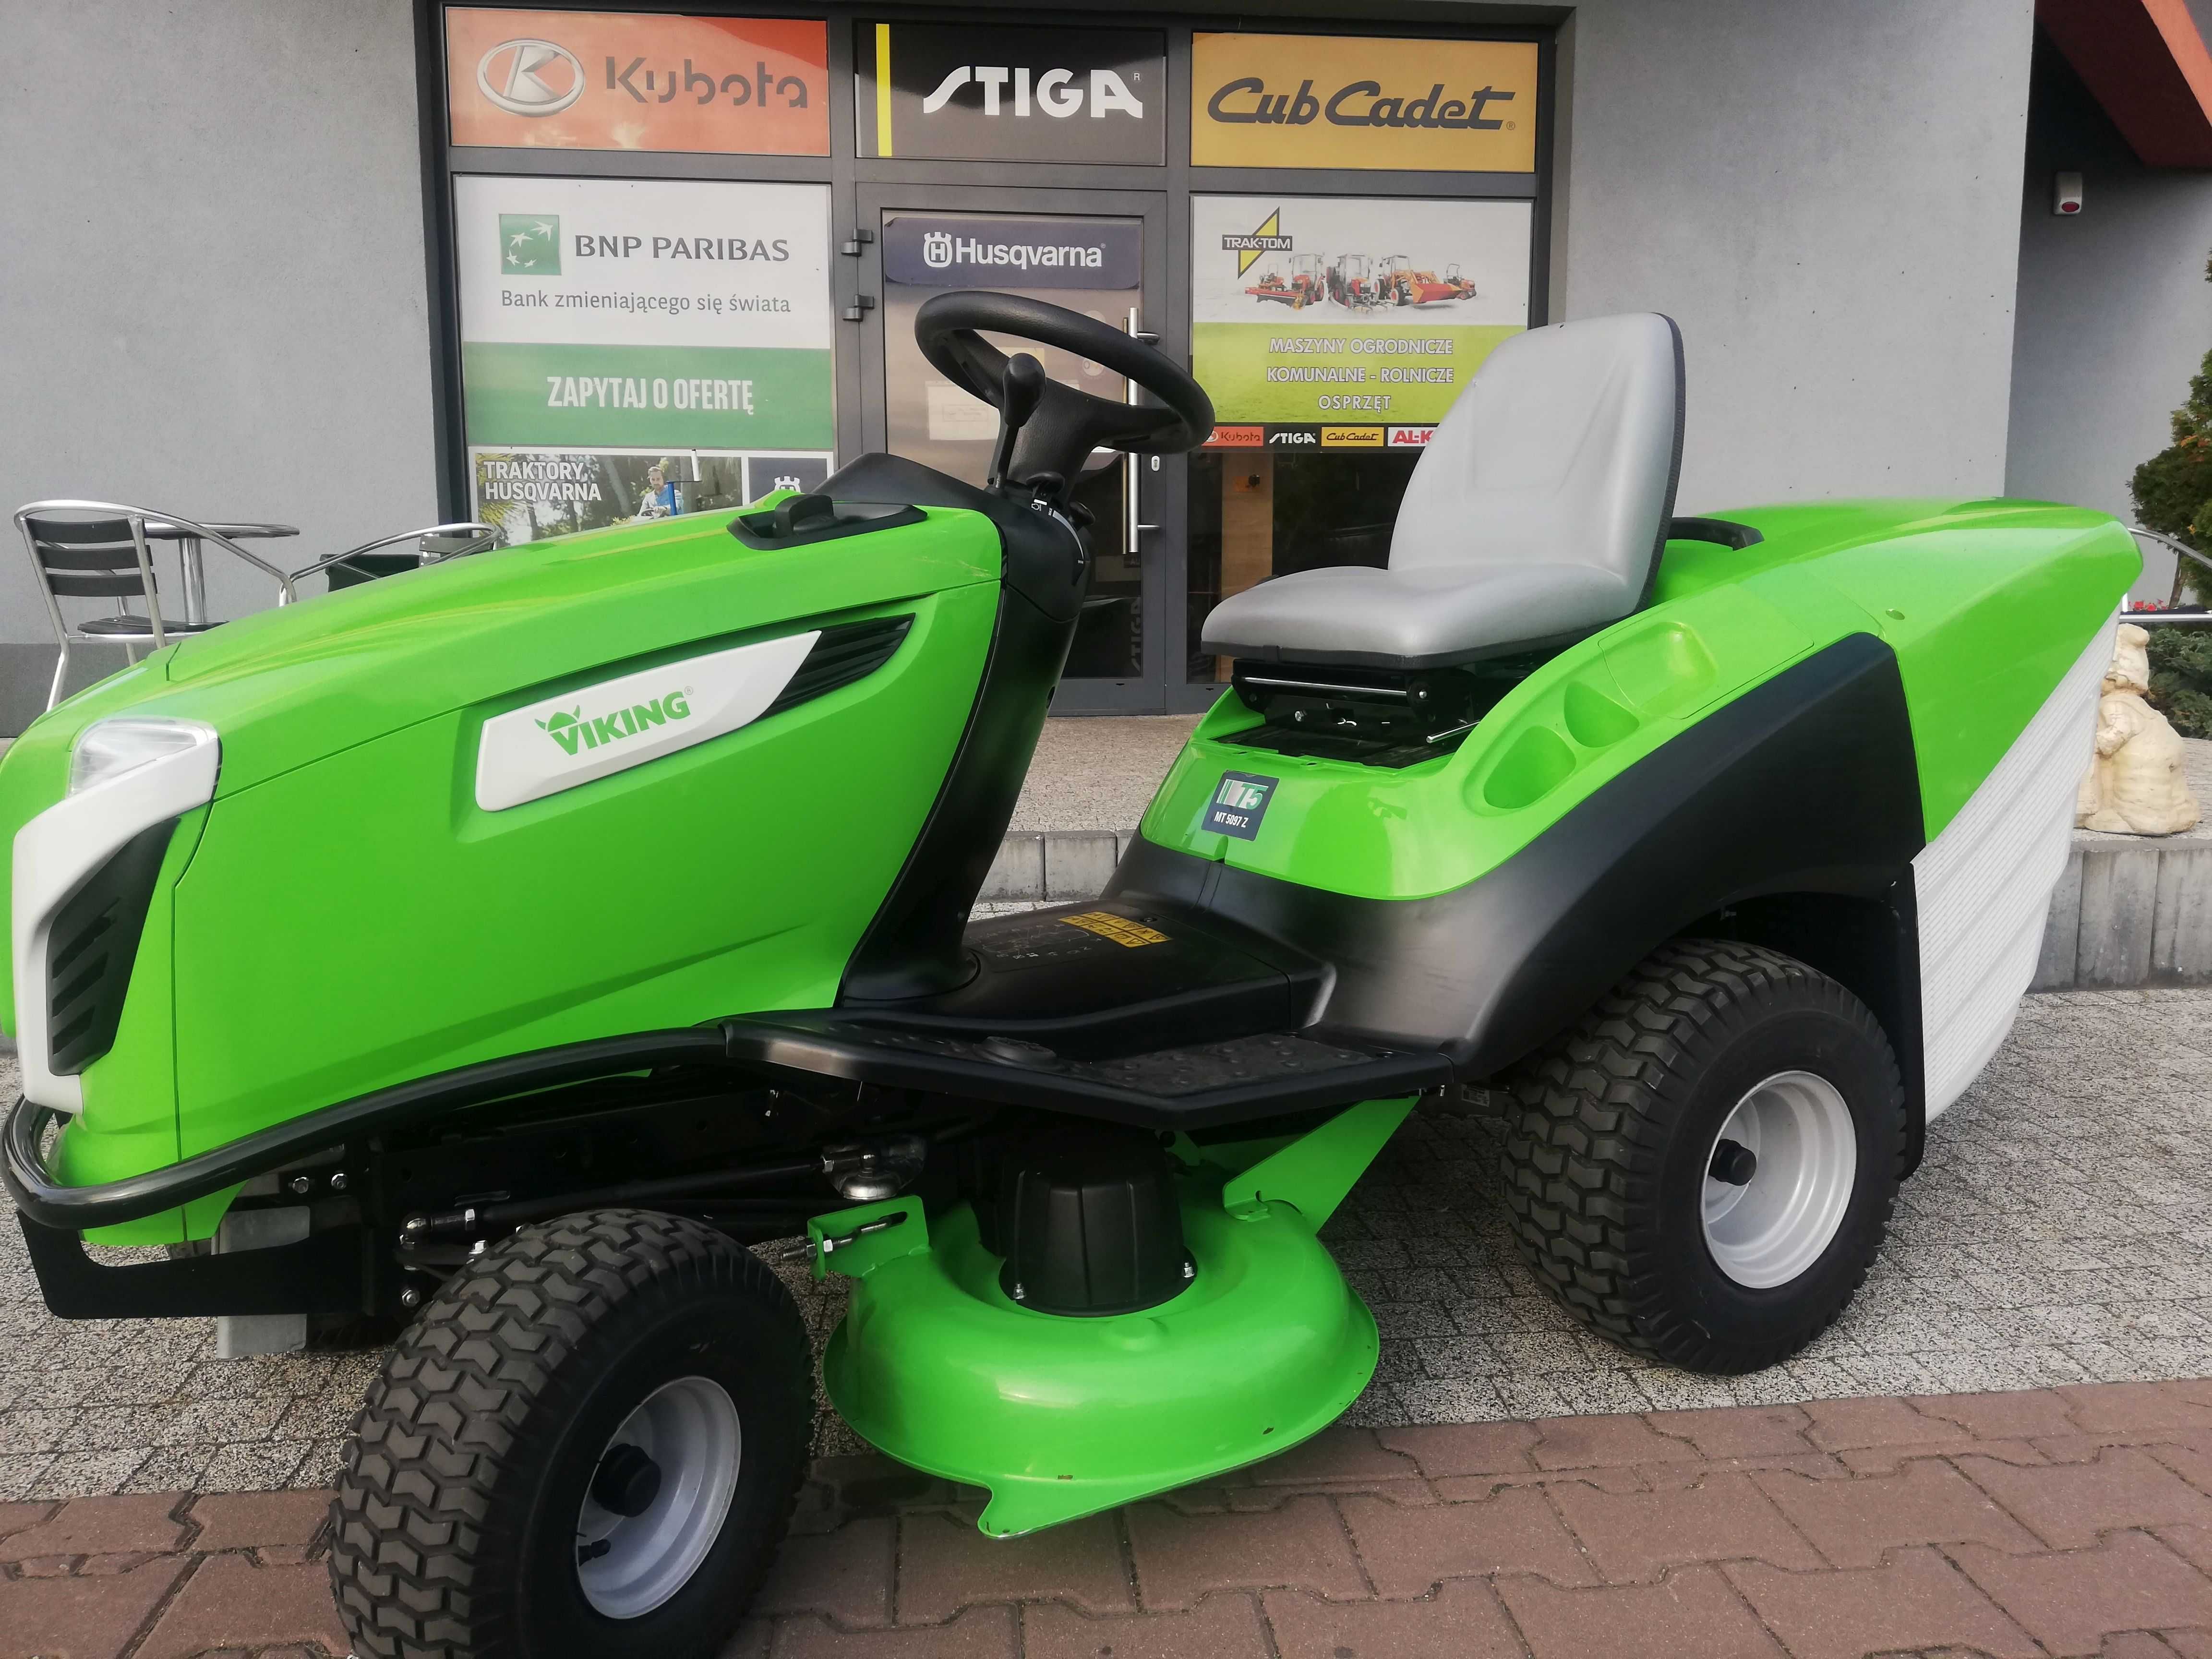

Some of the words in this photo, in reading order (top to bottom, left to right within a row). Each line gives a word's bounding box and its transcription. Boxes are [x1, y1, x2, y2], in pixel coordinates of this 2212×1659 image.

[605, 56, 808, 108] Kubota
[923, 66, 1142, 118] STIGA
[1207, 77, 1320, 125] Cub
[1324, 80, 1516, 130] Cadet
[575, 235, 642, 258] BNP
[652, 236, 790, 262] PARIBAS
[1224, 236, 1291, 250] TRAK-TOM
[956, 238, 1102, 269] Husqvarna
[501, 289, 548, 308] Bank
[554, 291, 690, 314] zmieniającego
[697, 294, 722, 314] się
[729, 293, 791, 313] świata
[1269, 337, 1346, 354] MASZYNY
[1350, 338, 1453, 355] OGRODNICZE
[1267, 367, 1366, 383] KOMUNALNE
[1380, 368, 1454, 384] ROLNICZE
[547, 376, 647, 408] ZAPYTAJ
[653, 378, 668, 409] O
[673, 379, 754, 415] OFERTĘ
[1318, 395, 1392, 413] OSPRZĘT
[1221, 432, 1261, 441] Kubota
[1269, 433, 1316, 444] STIGA
[1326, 433, 1345, 441] Cub
[1346, 433, 1379, 441] Cadet
[483, 461, 584, 480] TRAKTORY
[485, 482, 601, 502] HUSQVARNA
[550, 691, 691, 756] VIKING
[1214, 811, 1226, 823] MT
[1226, 814, 1242, 826] 5097
[1240, 817, 1249, 828] Z
